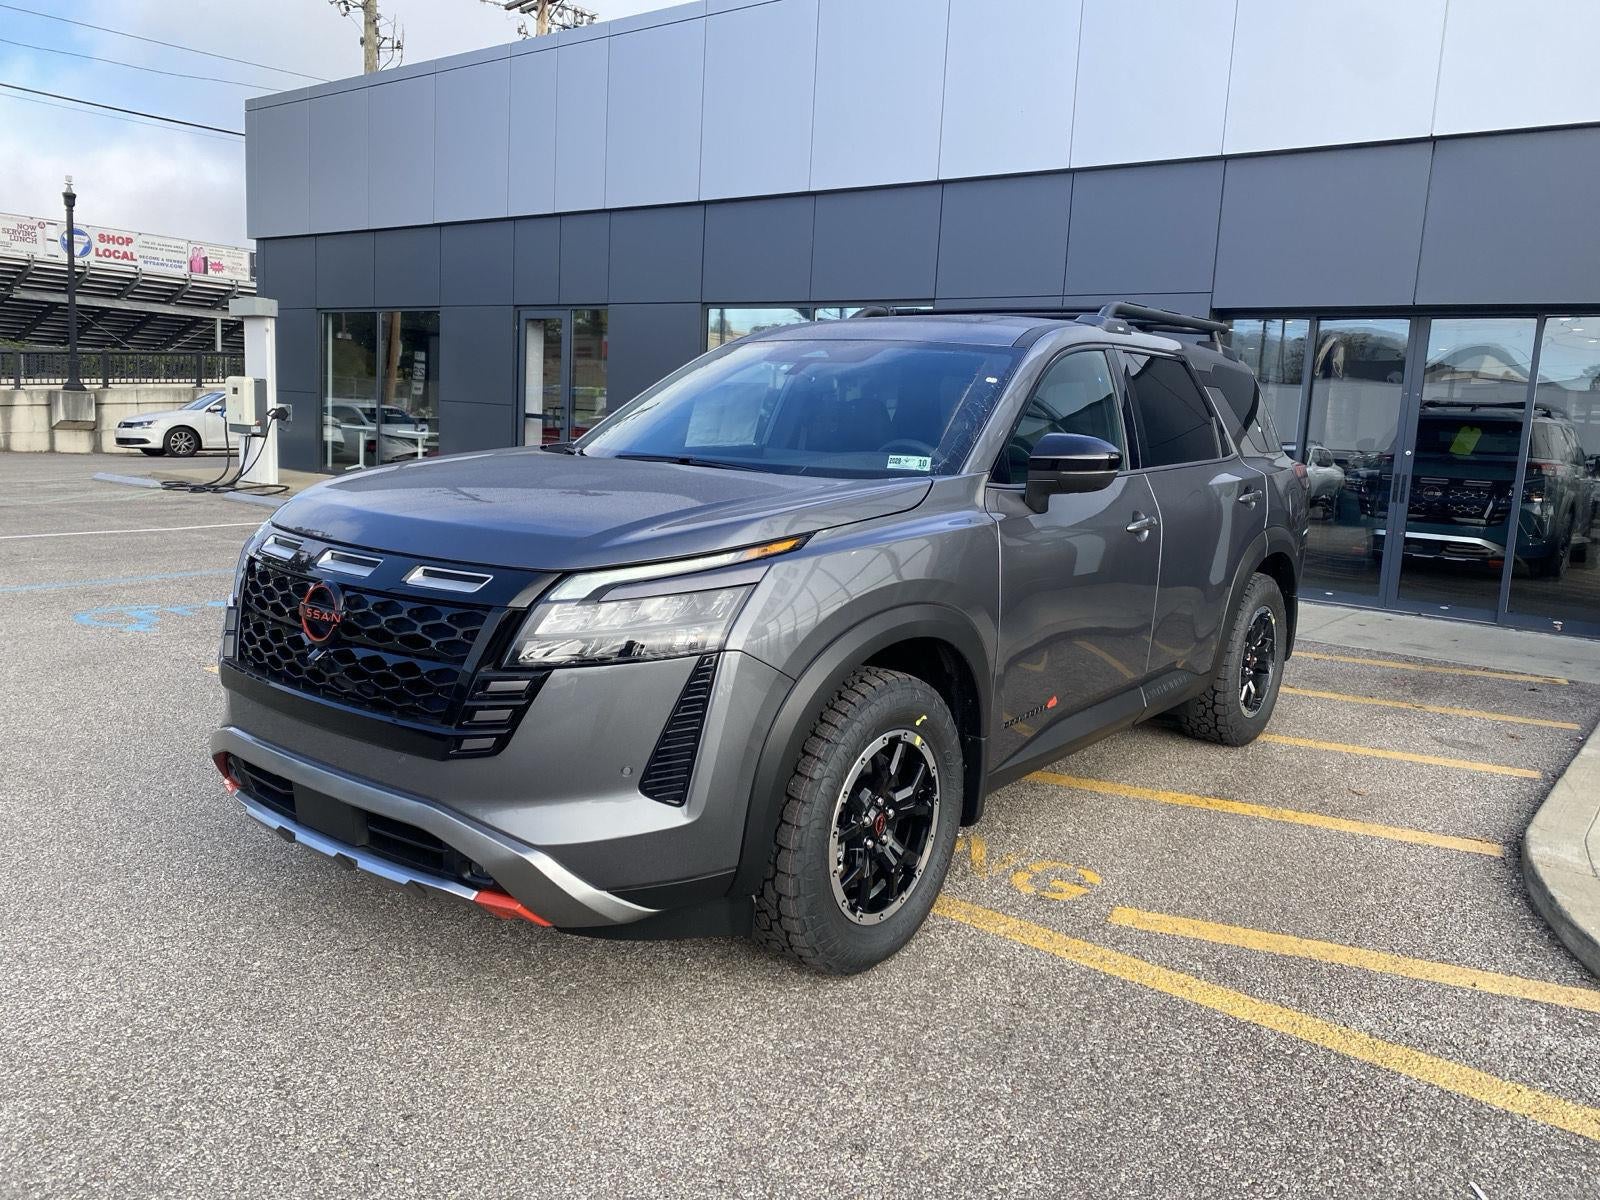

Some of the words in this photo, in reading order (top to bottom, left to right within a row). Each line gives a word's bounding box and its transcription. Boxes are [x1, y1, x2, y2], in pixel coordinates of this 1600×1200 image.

[1, 227, 37, 238] SERVING
[17, 223, 37, 231] NOW
[9, 235, 37, 244] LUNCH
[98, 233, 133, 246] SHOP
[95, 247, 137, 261] LOCAL
[918, 459, 927, 467] 10
[304, 606, 341, 623] SSAN
